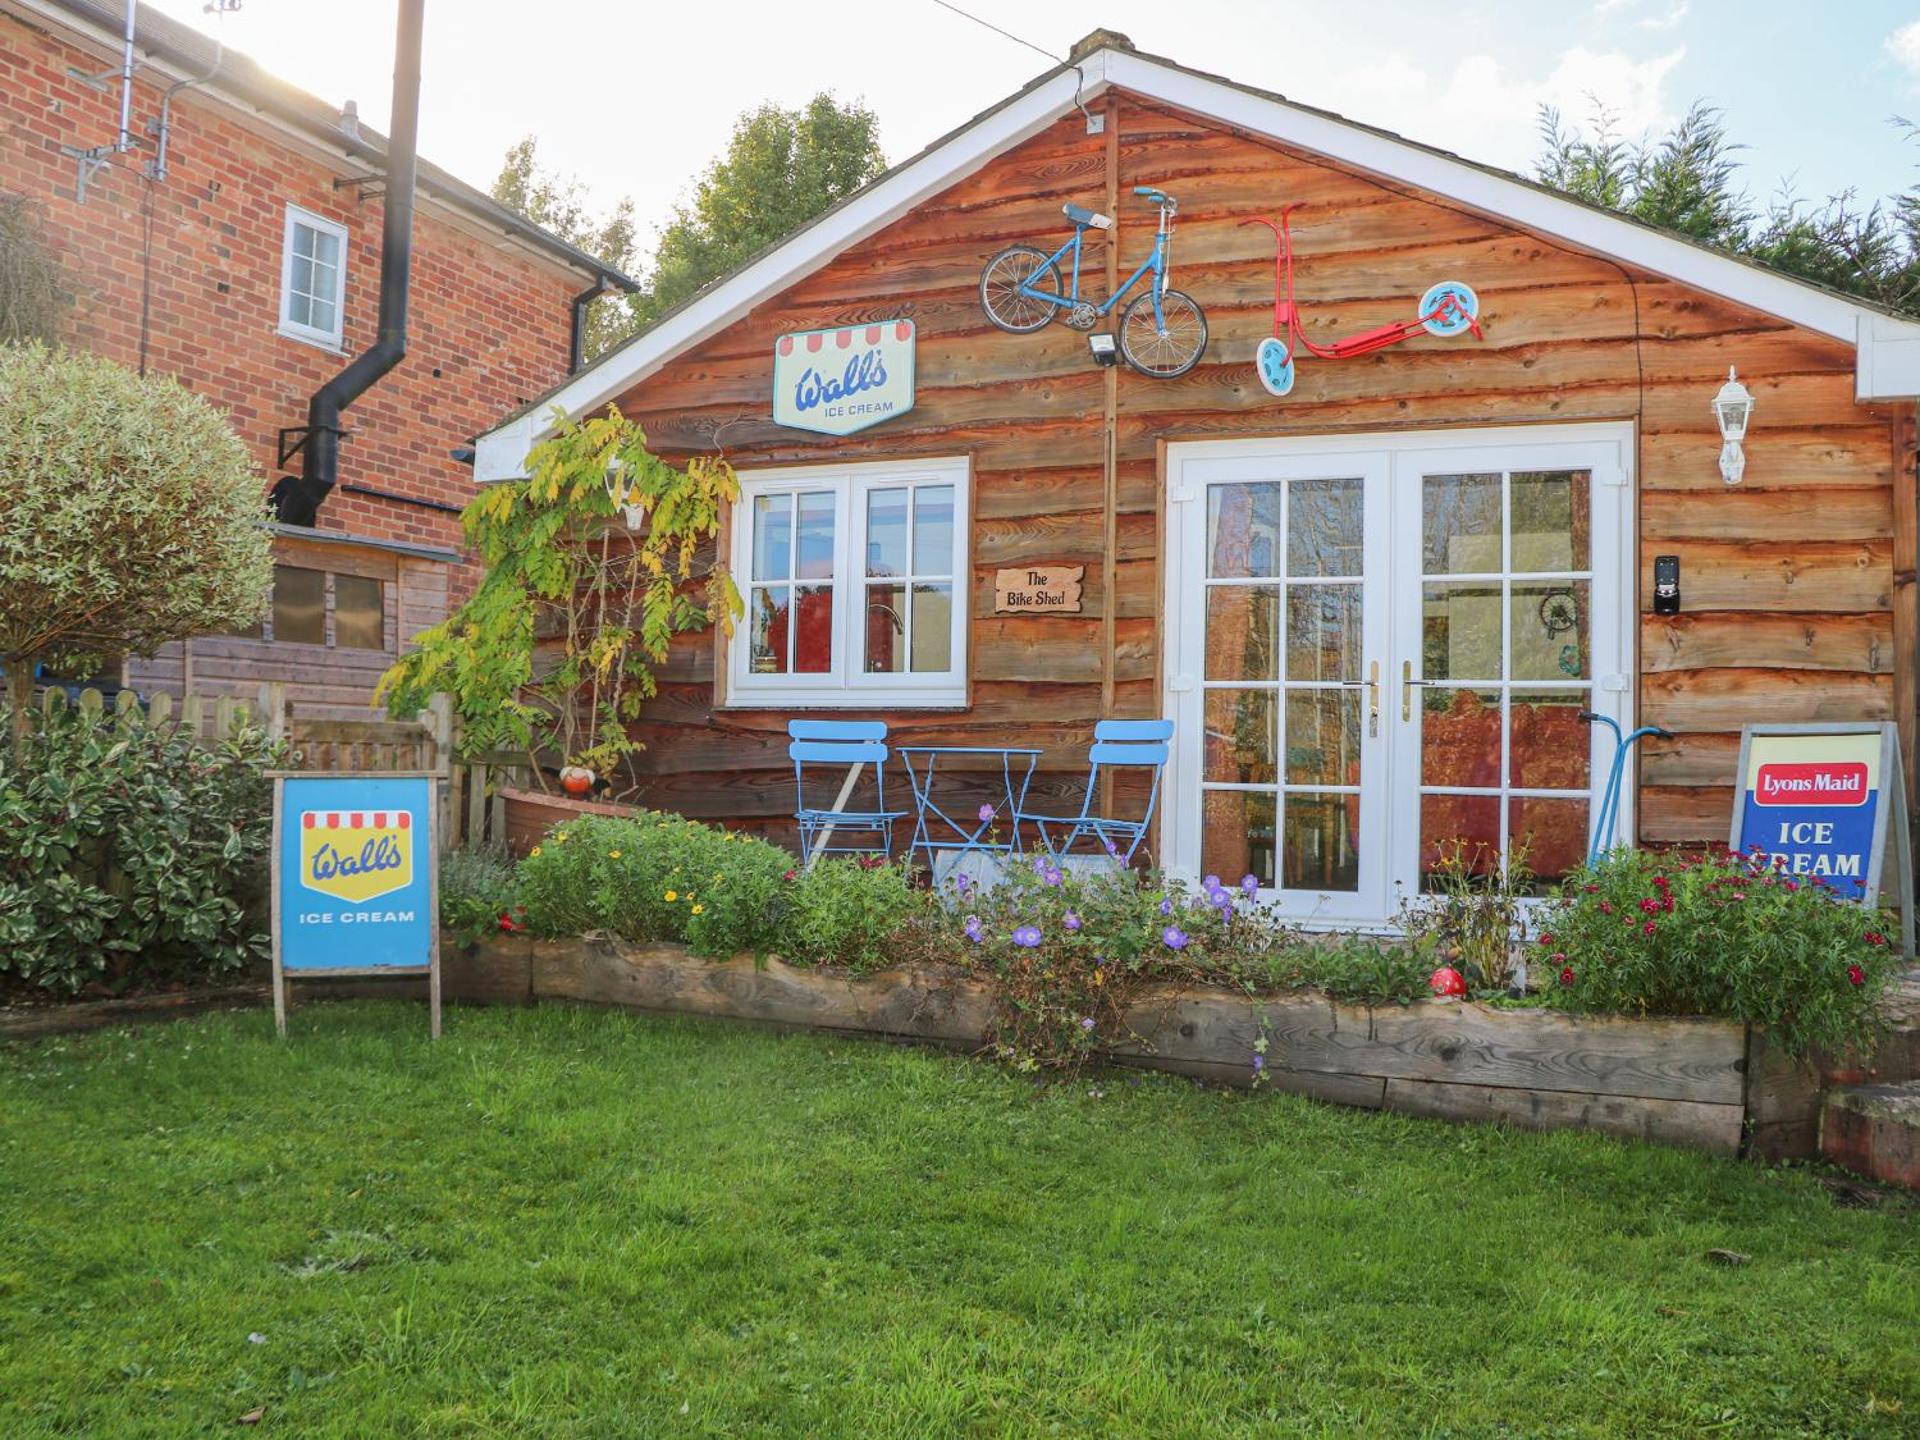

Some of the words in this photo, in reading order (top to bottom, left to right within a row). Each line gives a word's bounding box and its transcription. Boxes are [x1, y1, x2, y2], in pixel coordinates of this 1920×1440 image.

[795, 349, 887, 412] Wall's
[824, 406, 845, 418] ICE
[848, 401, 893, 416] CREAM
[1026, 571, 1048, 586] The
[1007, 592, 1033, 606] Bike
[1035, 590, 1065, 605] Shed
[1763, 774, 1812, 796] Lyons
[1813, 773, 1860, 791] Maid
[1778, 822, 1834, 844] ICE
[311, 834, 402, 881] Wall's
[299, 912, 333, 925] ICE
[340, 911, 415, 924] CREAM
